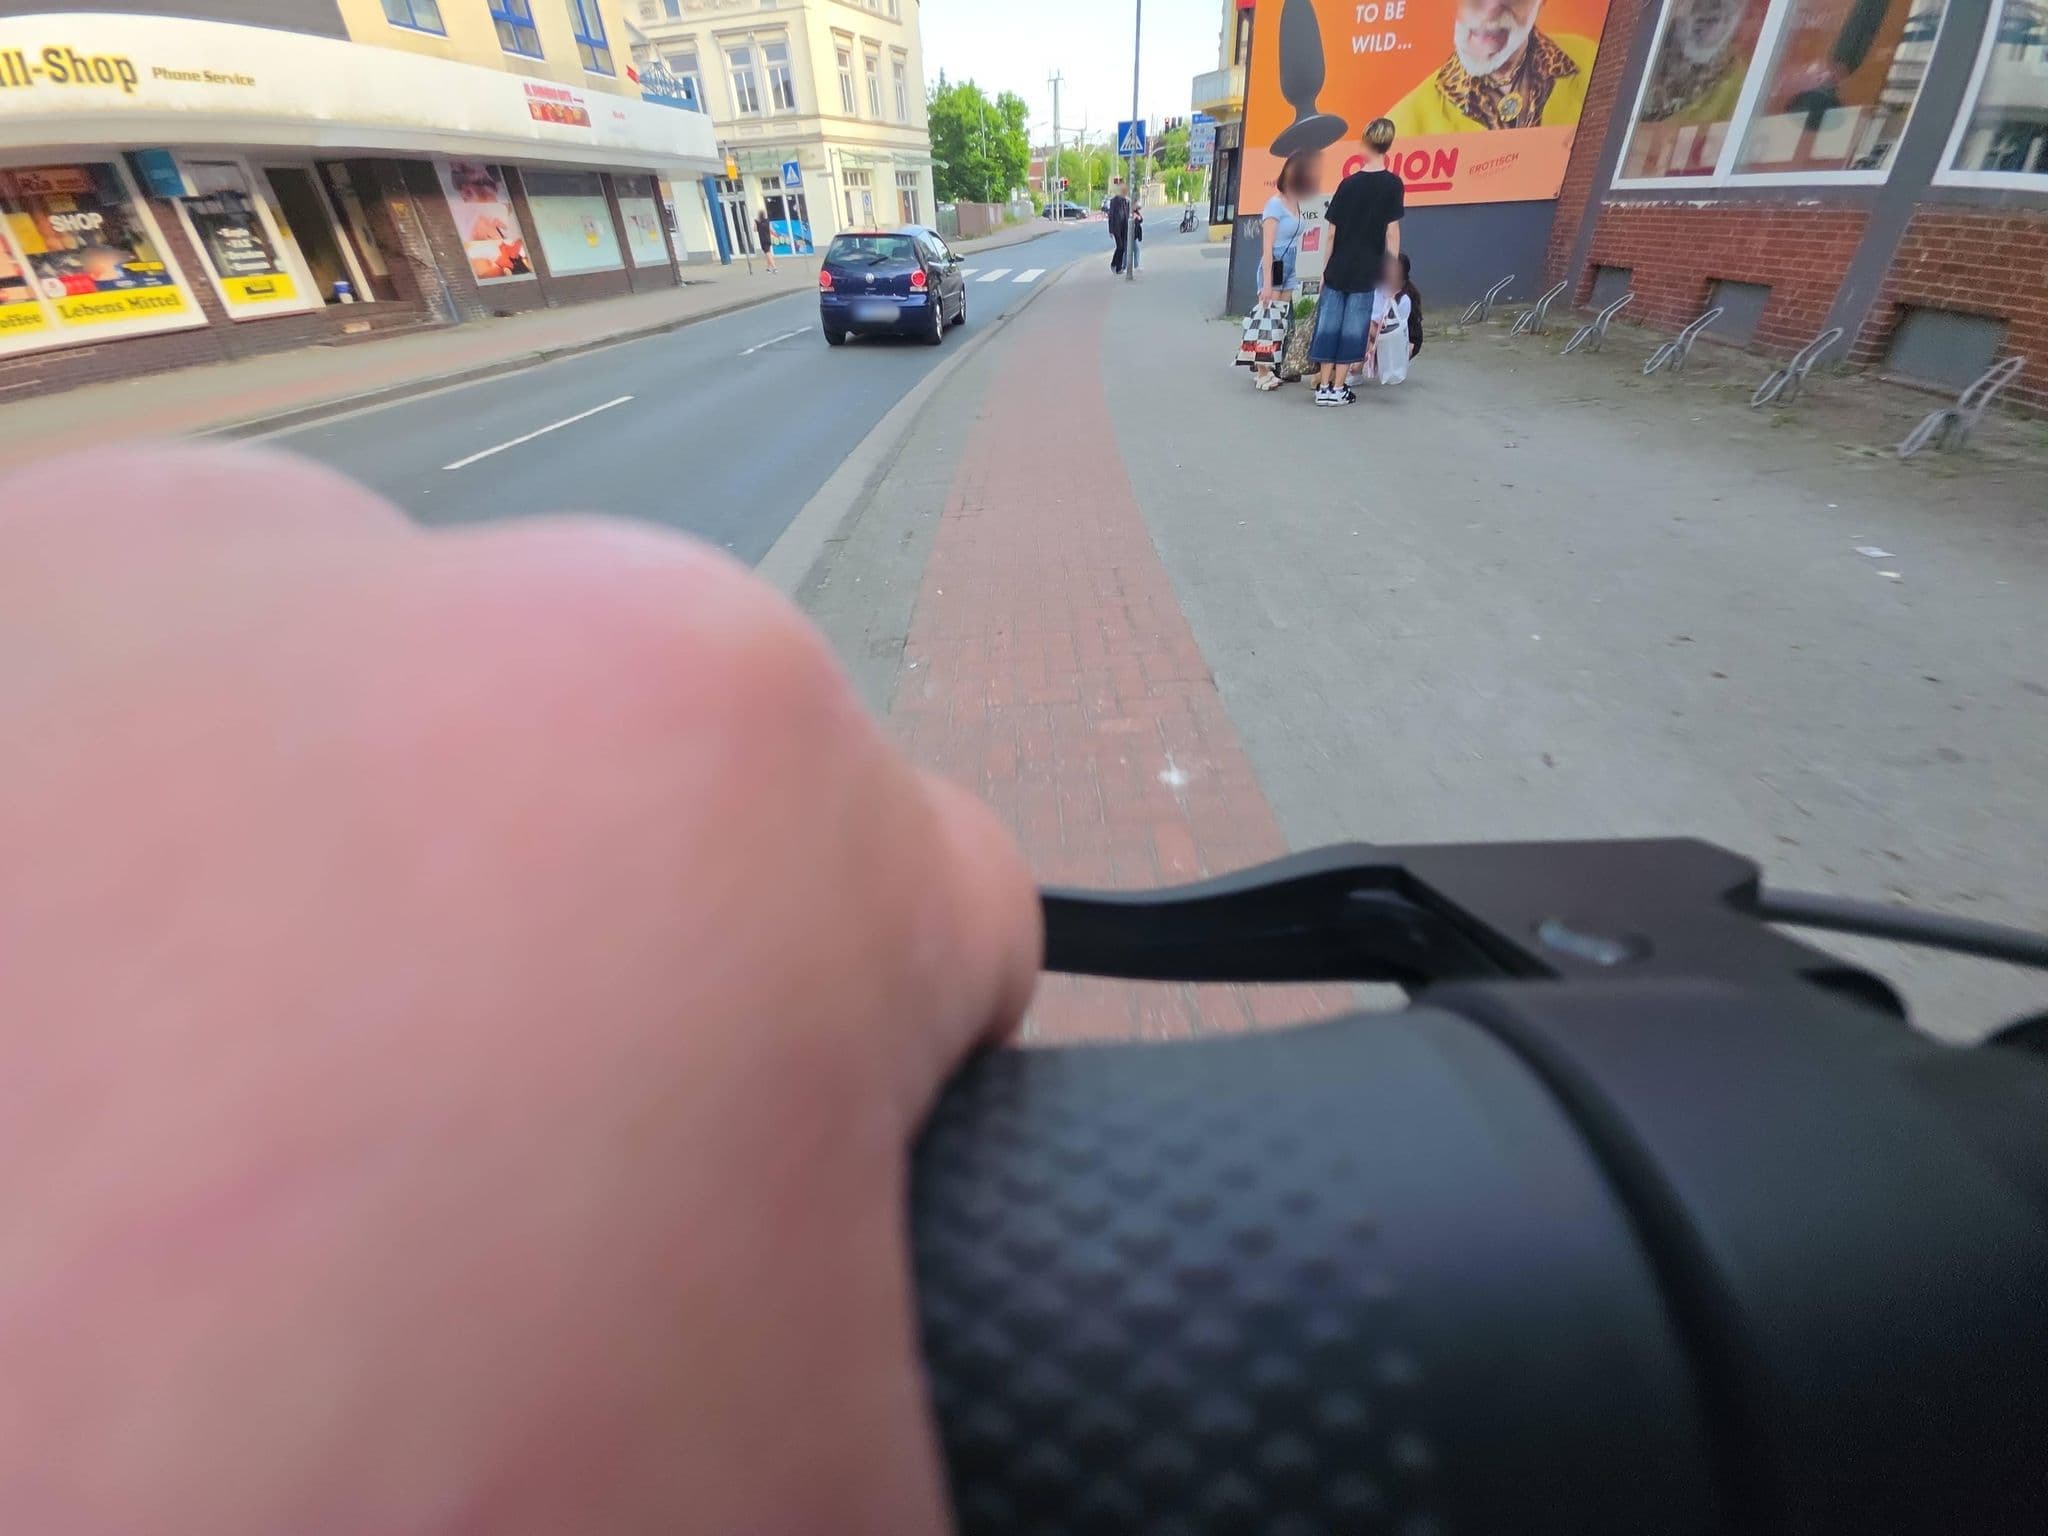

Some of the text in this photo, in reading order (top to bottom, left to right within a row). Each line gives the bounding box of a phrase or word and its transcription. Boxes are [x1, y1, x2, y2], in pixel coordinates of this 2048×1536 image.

[1356, 0, 1406, 24] TO BE
[1351, 32, 1413, 54] WILD...
[0, 47, 139, 94] ll-Shop
[151, 66, 256, 87] Phone Service
[48, 212, 104, 233] SHOP
[57, 302, 125, 320] Lebens
